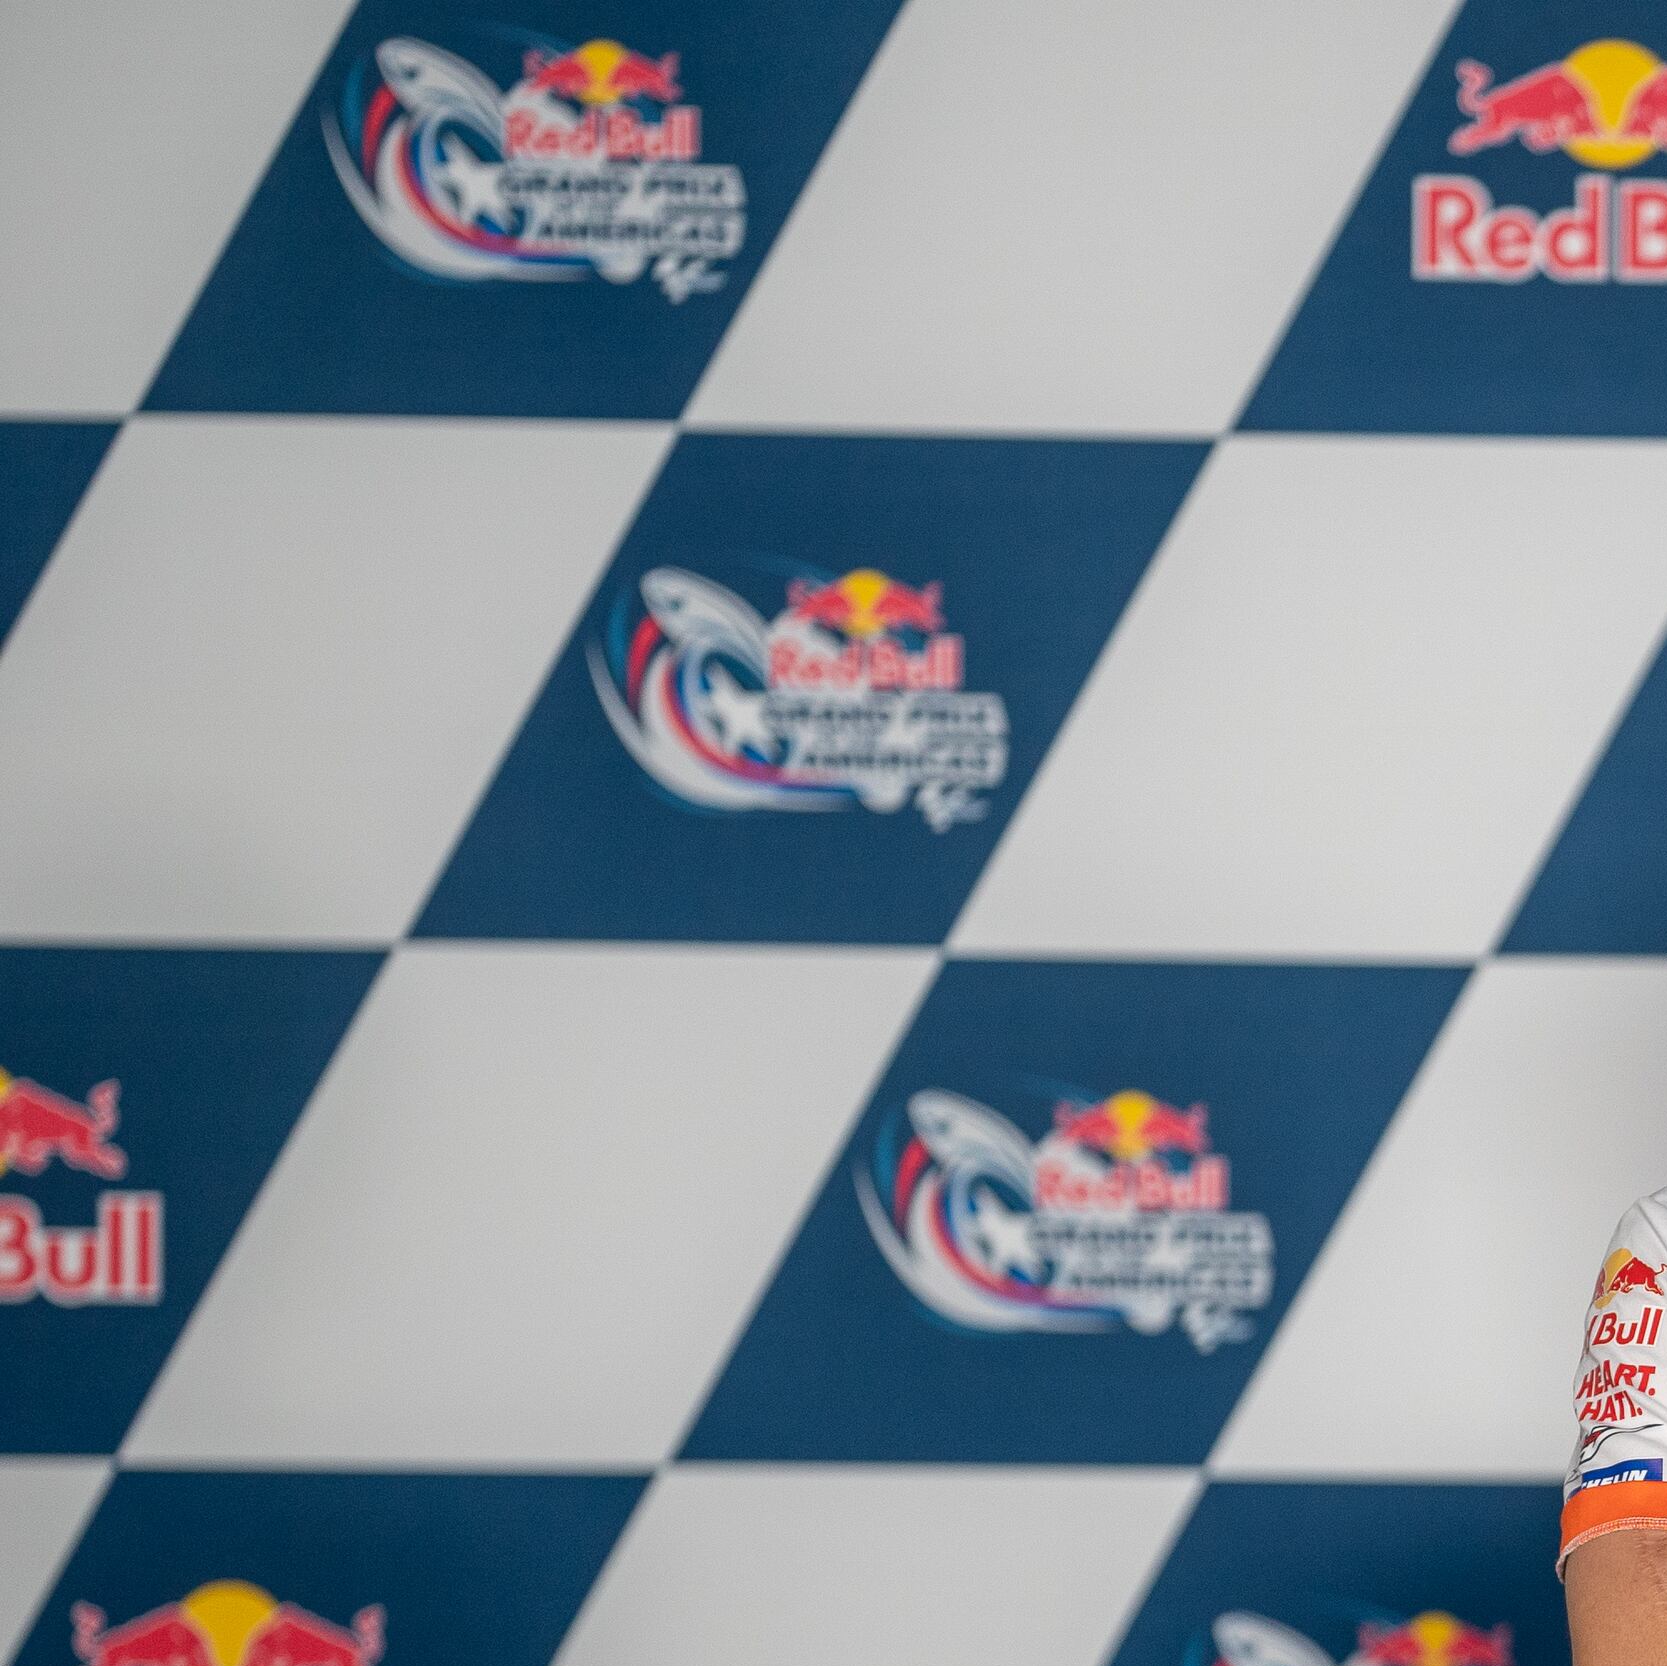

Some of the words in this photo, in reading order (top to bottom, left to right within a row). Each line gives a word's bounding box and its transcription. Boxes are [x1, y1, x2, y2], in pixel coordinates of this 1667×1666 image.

[506, 107, 597, 160] Red
[602, 107, 701, 162] Bull
[1417, 178, 1605, 280] Red
[768, 635, 860, 690] Red
[867, 633, 964, 690] Bull
[1036, 1157, 1128, 1212] Red
[1133, 1155, 1229, 1212] Bull
[0, 1196, 157, 1298] Bull
[1591, 1306, 1664, 1347] Bull
[1575, 1359, 1657, 1400] HEART.
[1578, 1390, 1643, 1422] HATI.
